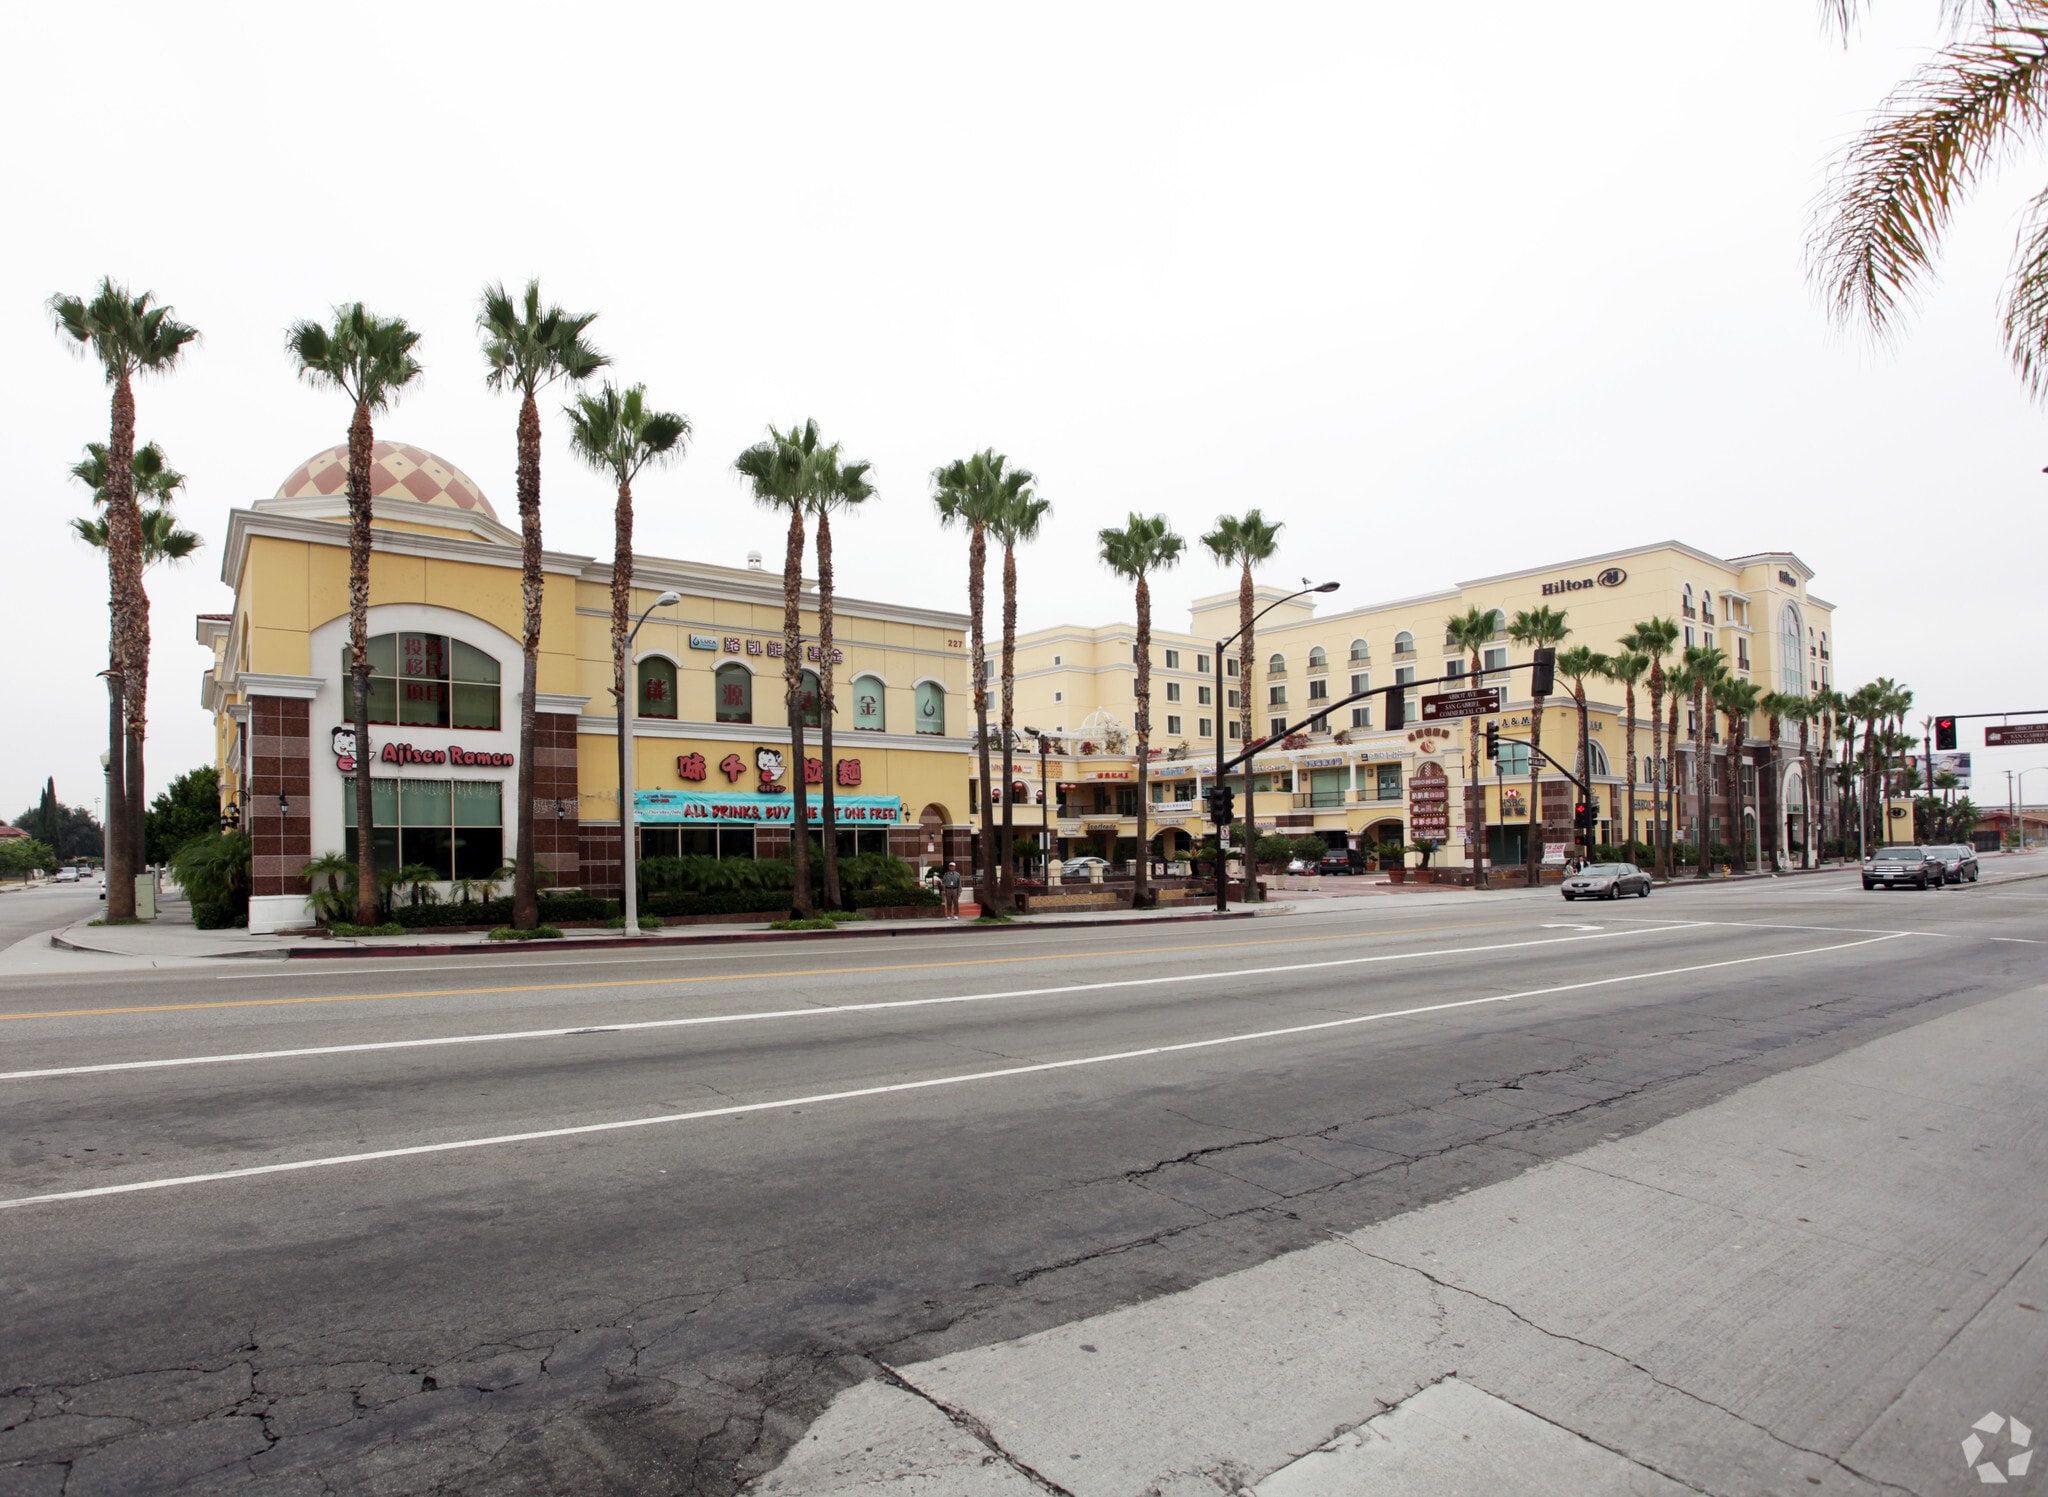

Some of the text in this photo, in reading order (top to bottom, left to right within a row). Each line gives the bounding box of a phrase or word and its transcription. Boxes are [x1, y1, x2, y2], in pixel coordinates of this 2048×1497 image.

[1541, 578, 1594, 596] Hilton
[947, 640, 963, 648] 227
[1447, 690, 1478, 701] ABBOT AVE
[1445, 700, 1480, 711] SAN GABRIEL
[1440, 708, 1474, 717] COMMERCIAL
[382, 743, 514, 766] Ajisen Ramen
[684, 804, 708, 818] ALL
[712, 805, 762, 820] DRINKS,
[765, 805, 791, 820] BUY
[844, 806, 866, 820] ONE
[869, 807, 897, 821] FREE!
